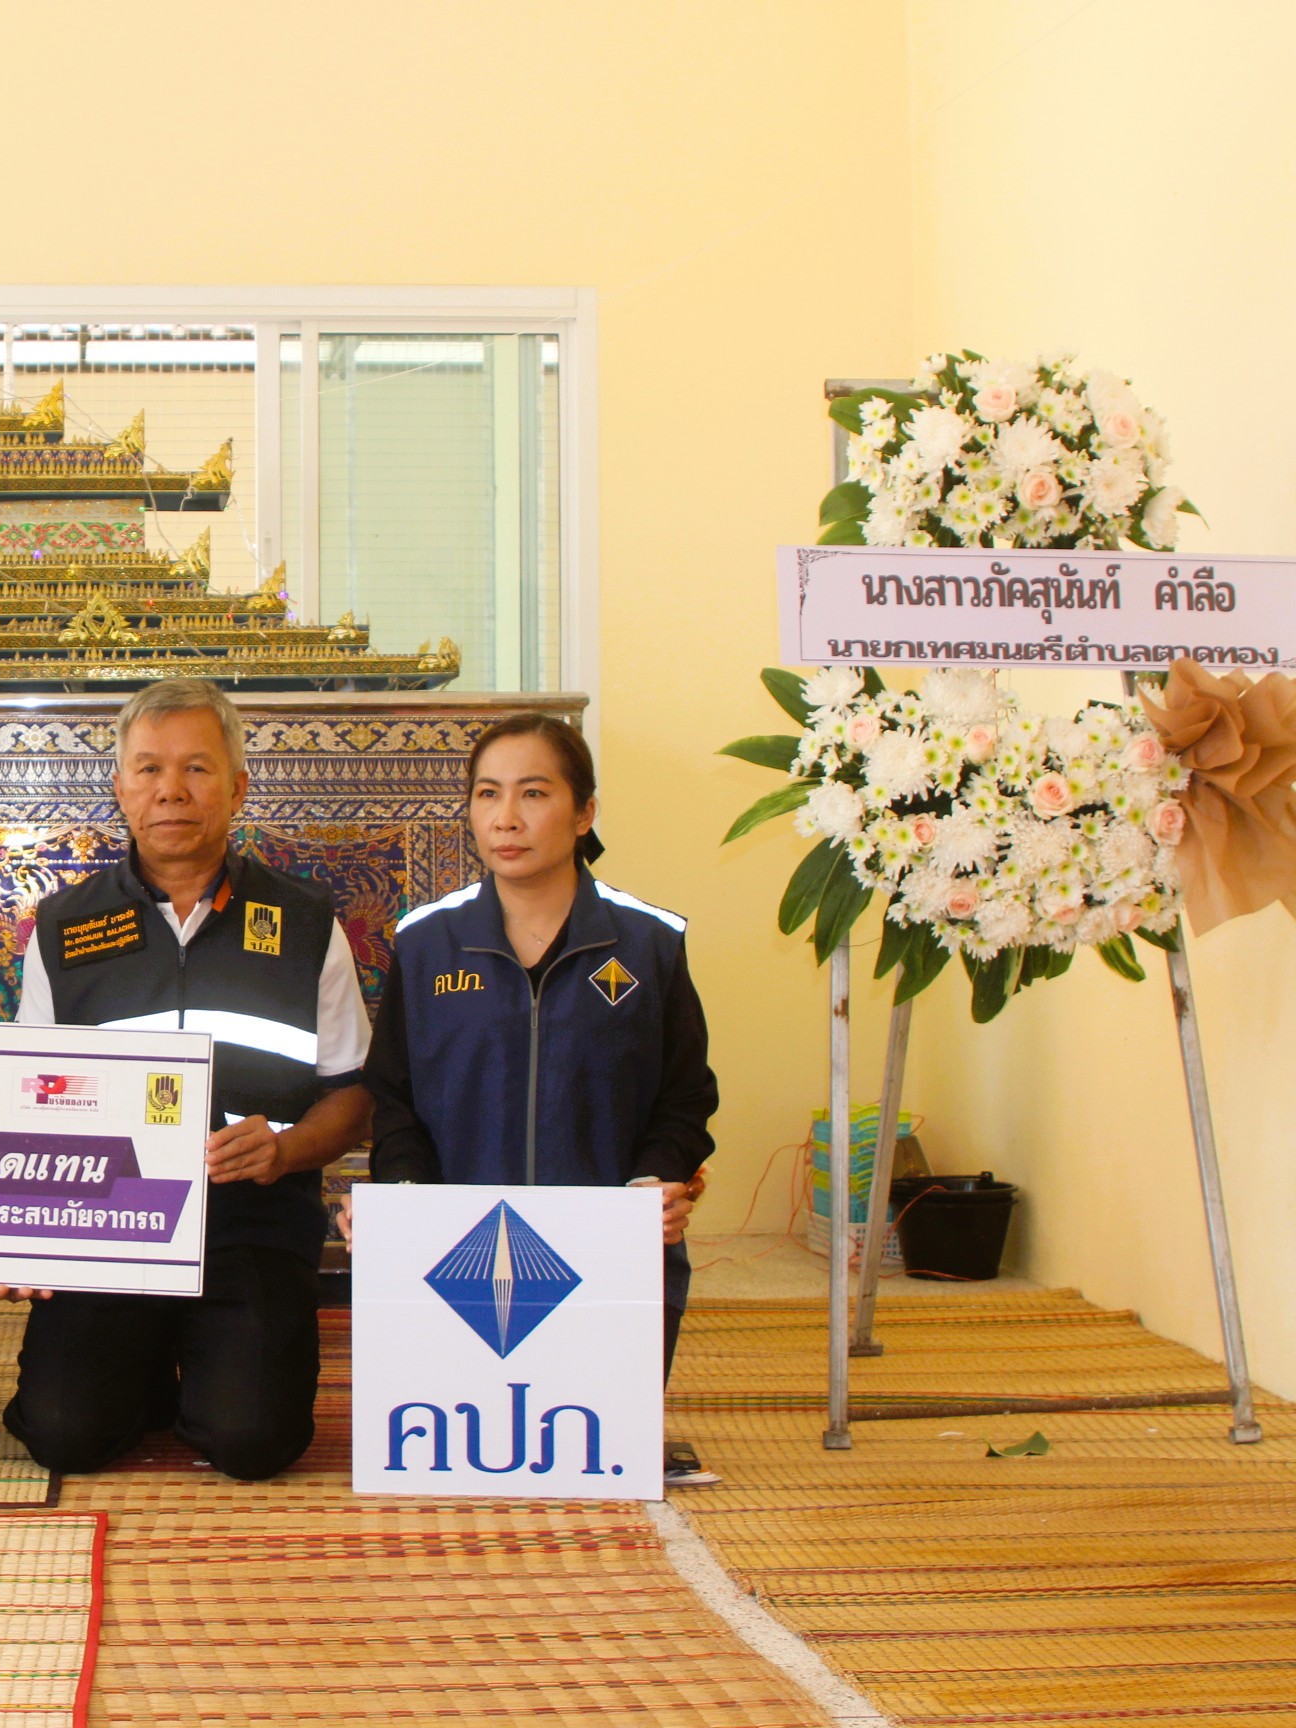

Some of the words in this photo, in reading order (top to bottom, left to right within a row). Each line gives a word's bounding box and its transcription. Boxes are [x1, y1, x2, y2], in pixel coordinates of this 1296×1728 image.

[862, 561, 1121, 625] นางสาวภัคสุนันท์
[1155, 566, 1236, 612] คำลือ
[827, 635, 1280, 665] นายกเทศมนตรีตำบลตาดทอง
[434, 969, 484, 996] คปภ.
[384, 1383, 624, 1477] คปภ.
